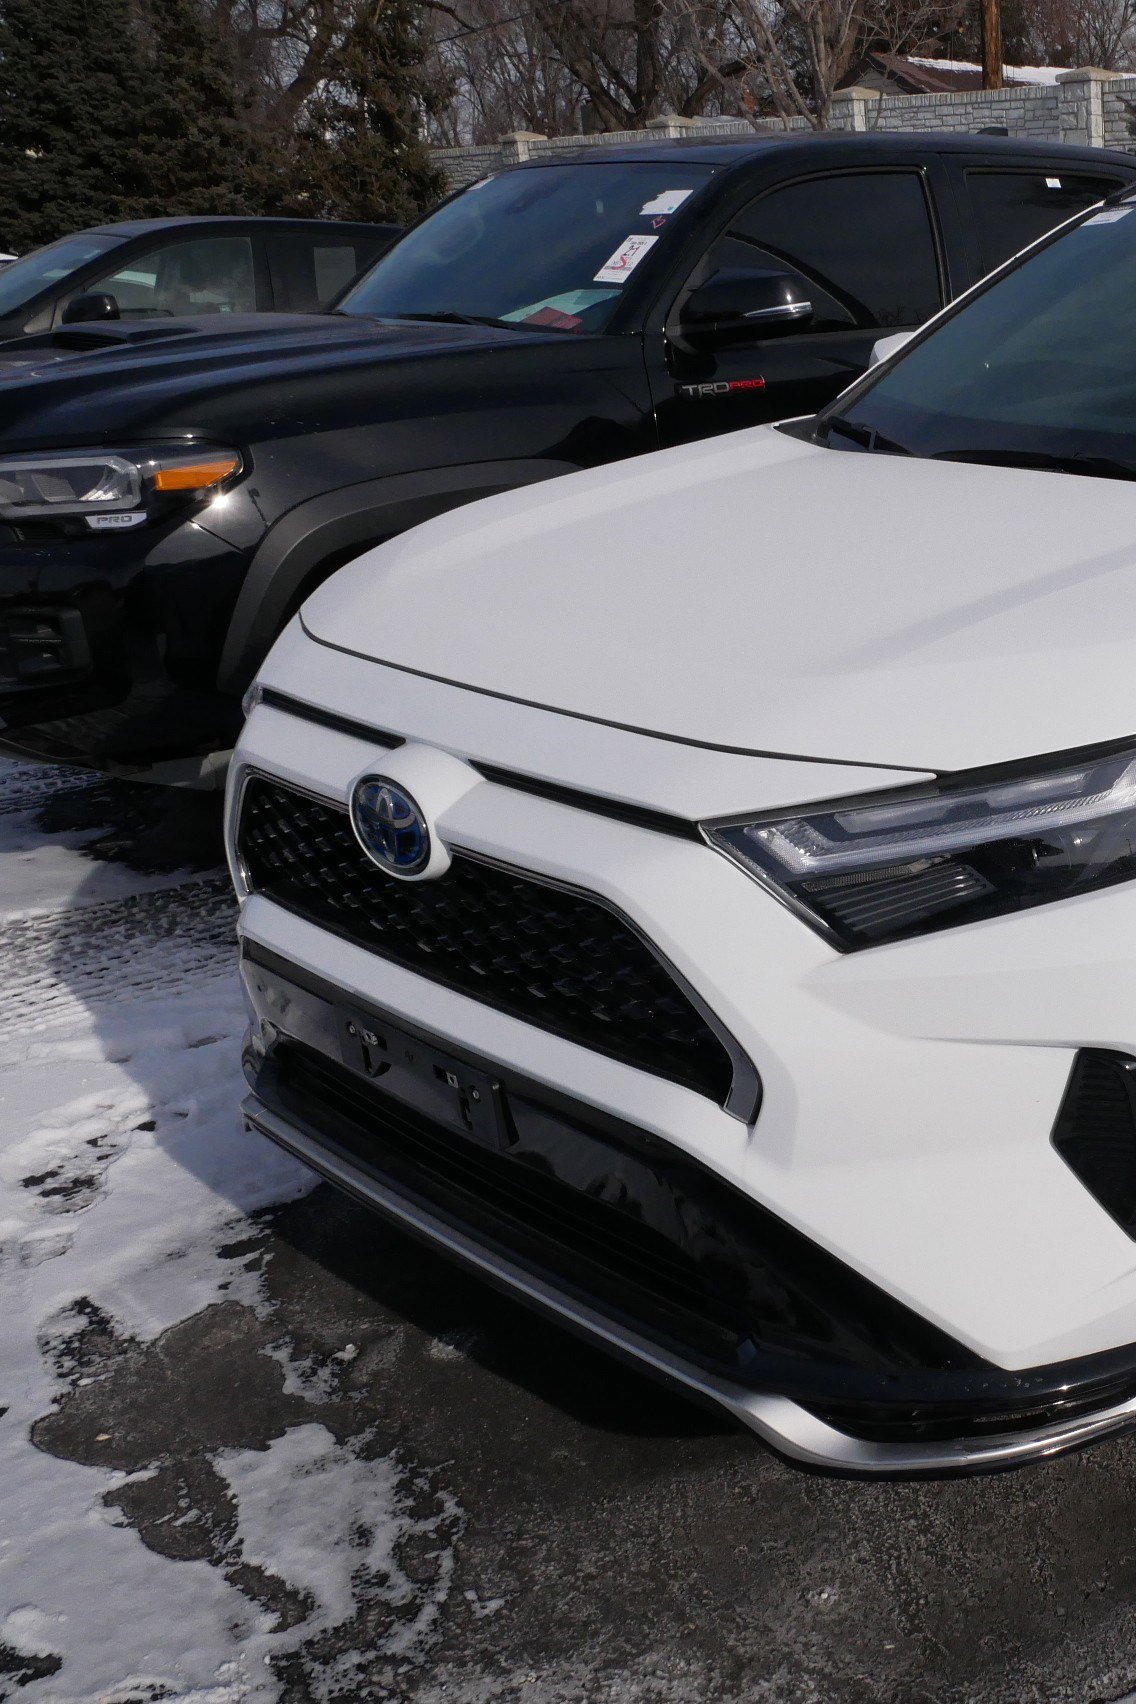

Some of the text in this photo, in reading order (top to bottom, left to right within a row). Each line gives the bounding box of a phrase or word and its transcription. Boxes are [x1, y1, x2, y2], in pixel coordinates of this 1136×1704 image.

[682, 379, 764, 397] TRD PRO
[97, 515, 132, 525] PRO
